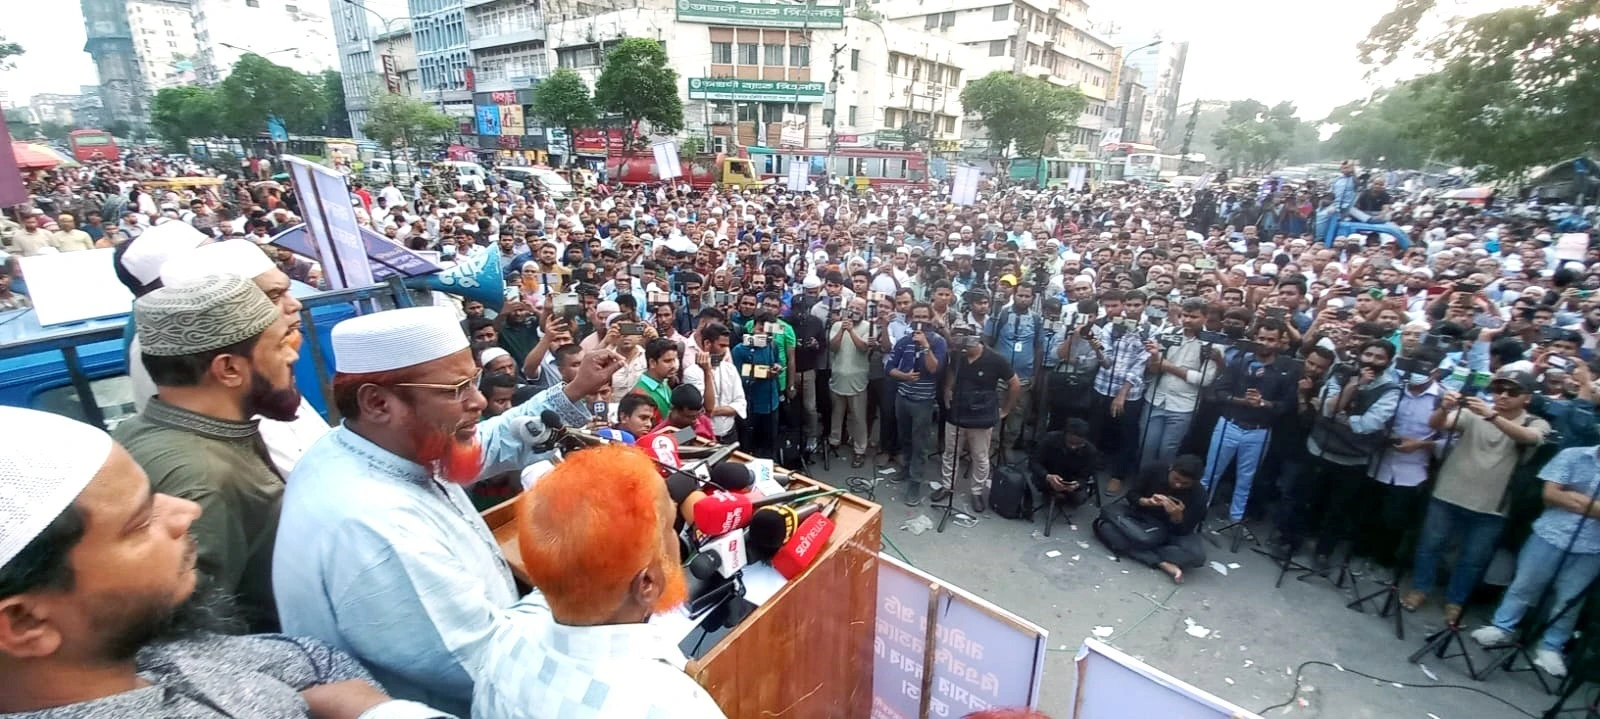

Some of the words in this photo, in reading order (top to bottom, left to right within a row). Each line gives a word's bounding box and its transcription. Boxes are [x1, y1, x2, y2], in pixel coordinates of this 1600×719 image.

[689, 2, 736, 13] অগ্রণী
[740, 6, 780, 16] ব্যাংক
[702, 79, 739, 89] অগ্রণী
[742, 82, 773, 90] ব্যাংক
[776, 82, 822, 91] পিএলসি
